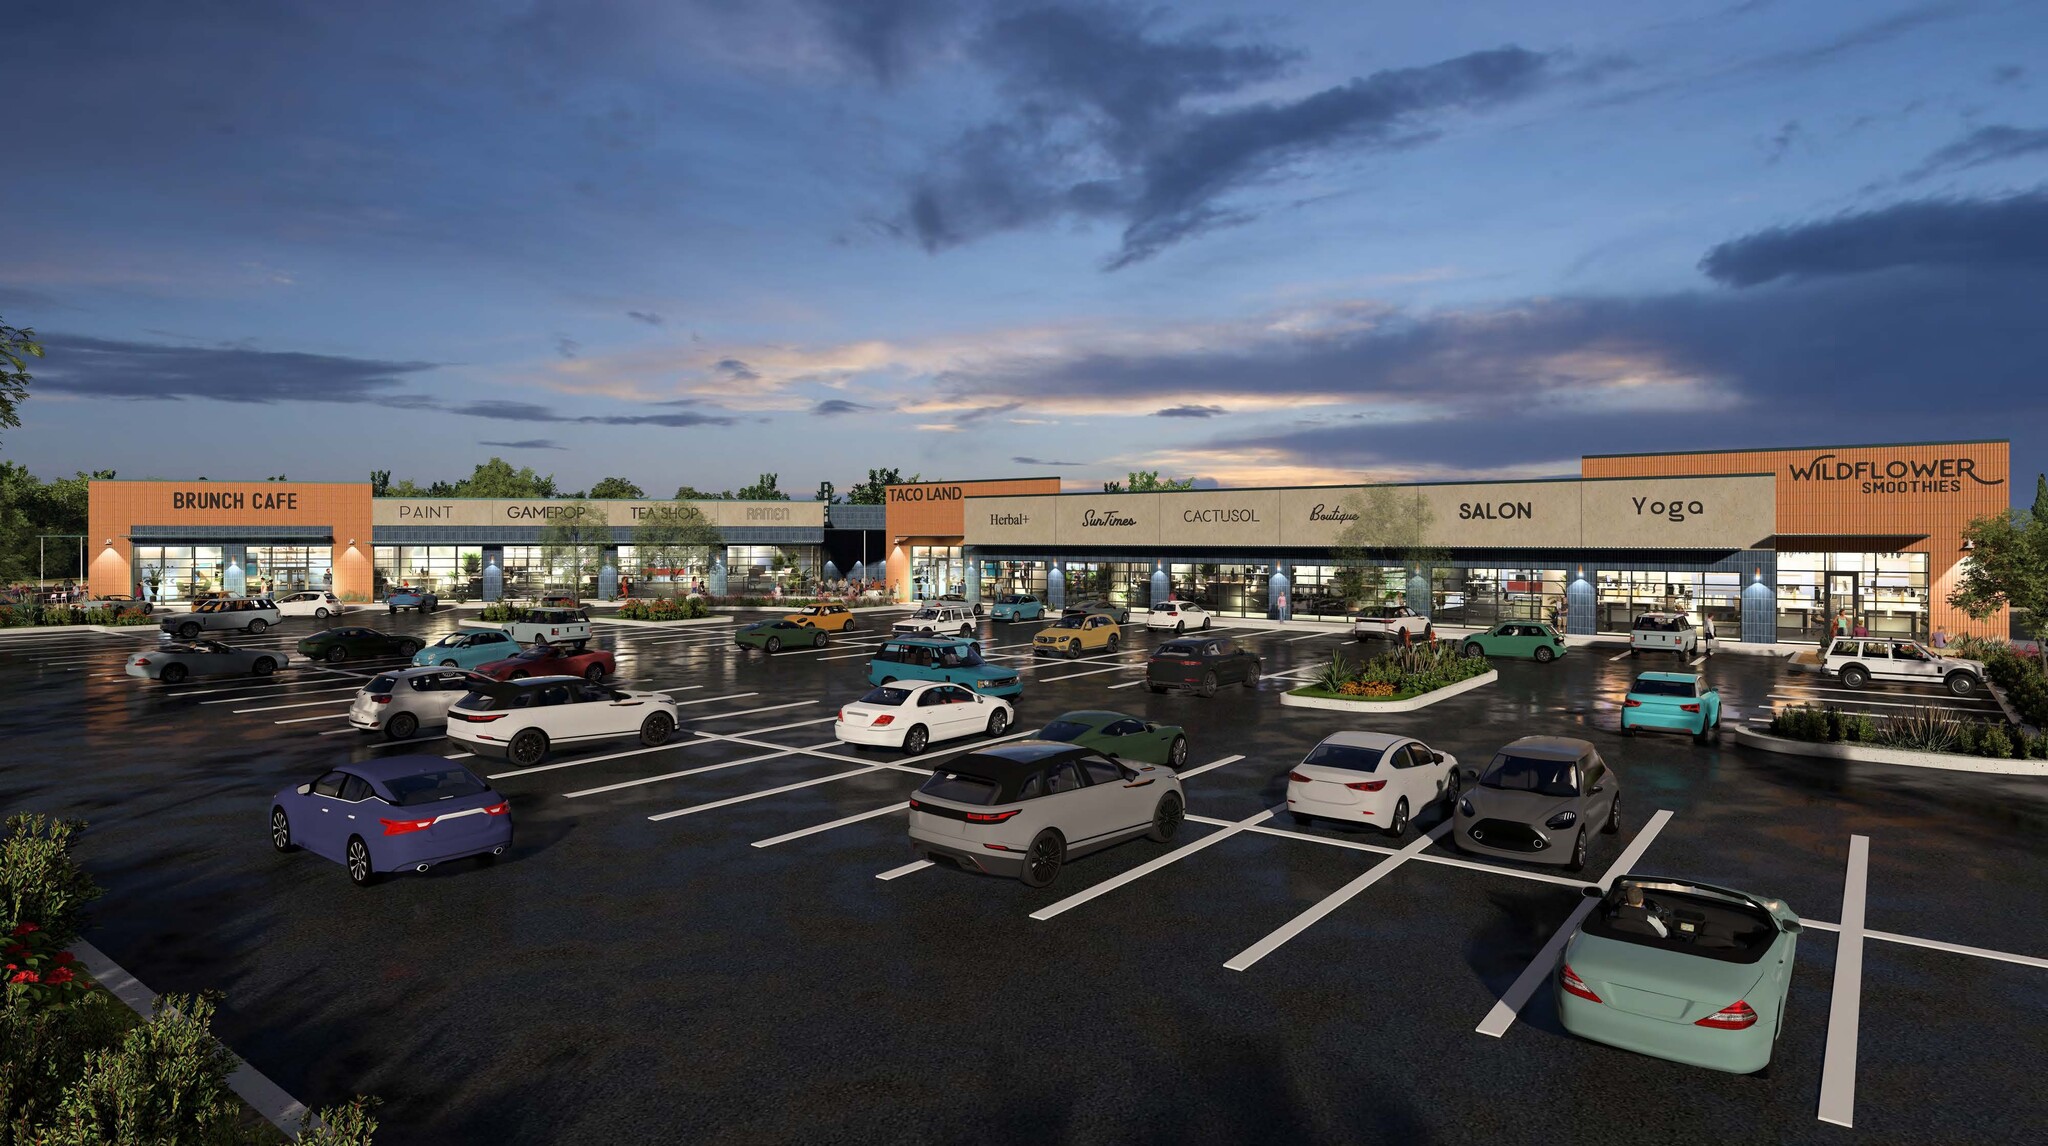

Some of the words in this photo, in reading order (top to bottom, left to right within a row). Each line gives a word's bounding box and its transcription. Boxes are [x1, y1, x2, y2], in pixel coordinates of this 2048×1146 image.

[1789, 454, 2004, 486] WILDFLOWER
[889, 487, 924, 502] TACO
[927, 486, 962, 501] LAND
[1862, 480, 1961, 494] SMOOTHIES
[173, 491, 244, 510] BRUNCH
[252, 492, 298, 510] CAFE
[399, 505, 454, 519] PAINT
[507, 506, 586, 519] GAMEPOP
[630, 506, 657, 520] TEA
[661, 507, 699, 520] SHOP
[1183, 509, 1260, 523] CACTUSOL
[1309, 503, 1360, 524] Boutique
[1459, 502, 1532, 520] SALON
[1631, 496, 1704, 522] Yoga
[990, 513, 1030, 526] Herbal+
[1081, 508, 1137, 527] SunTimes
